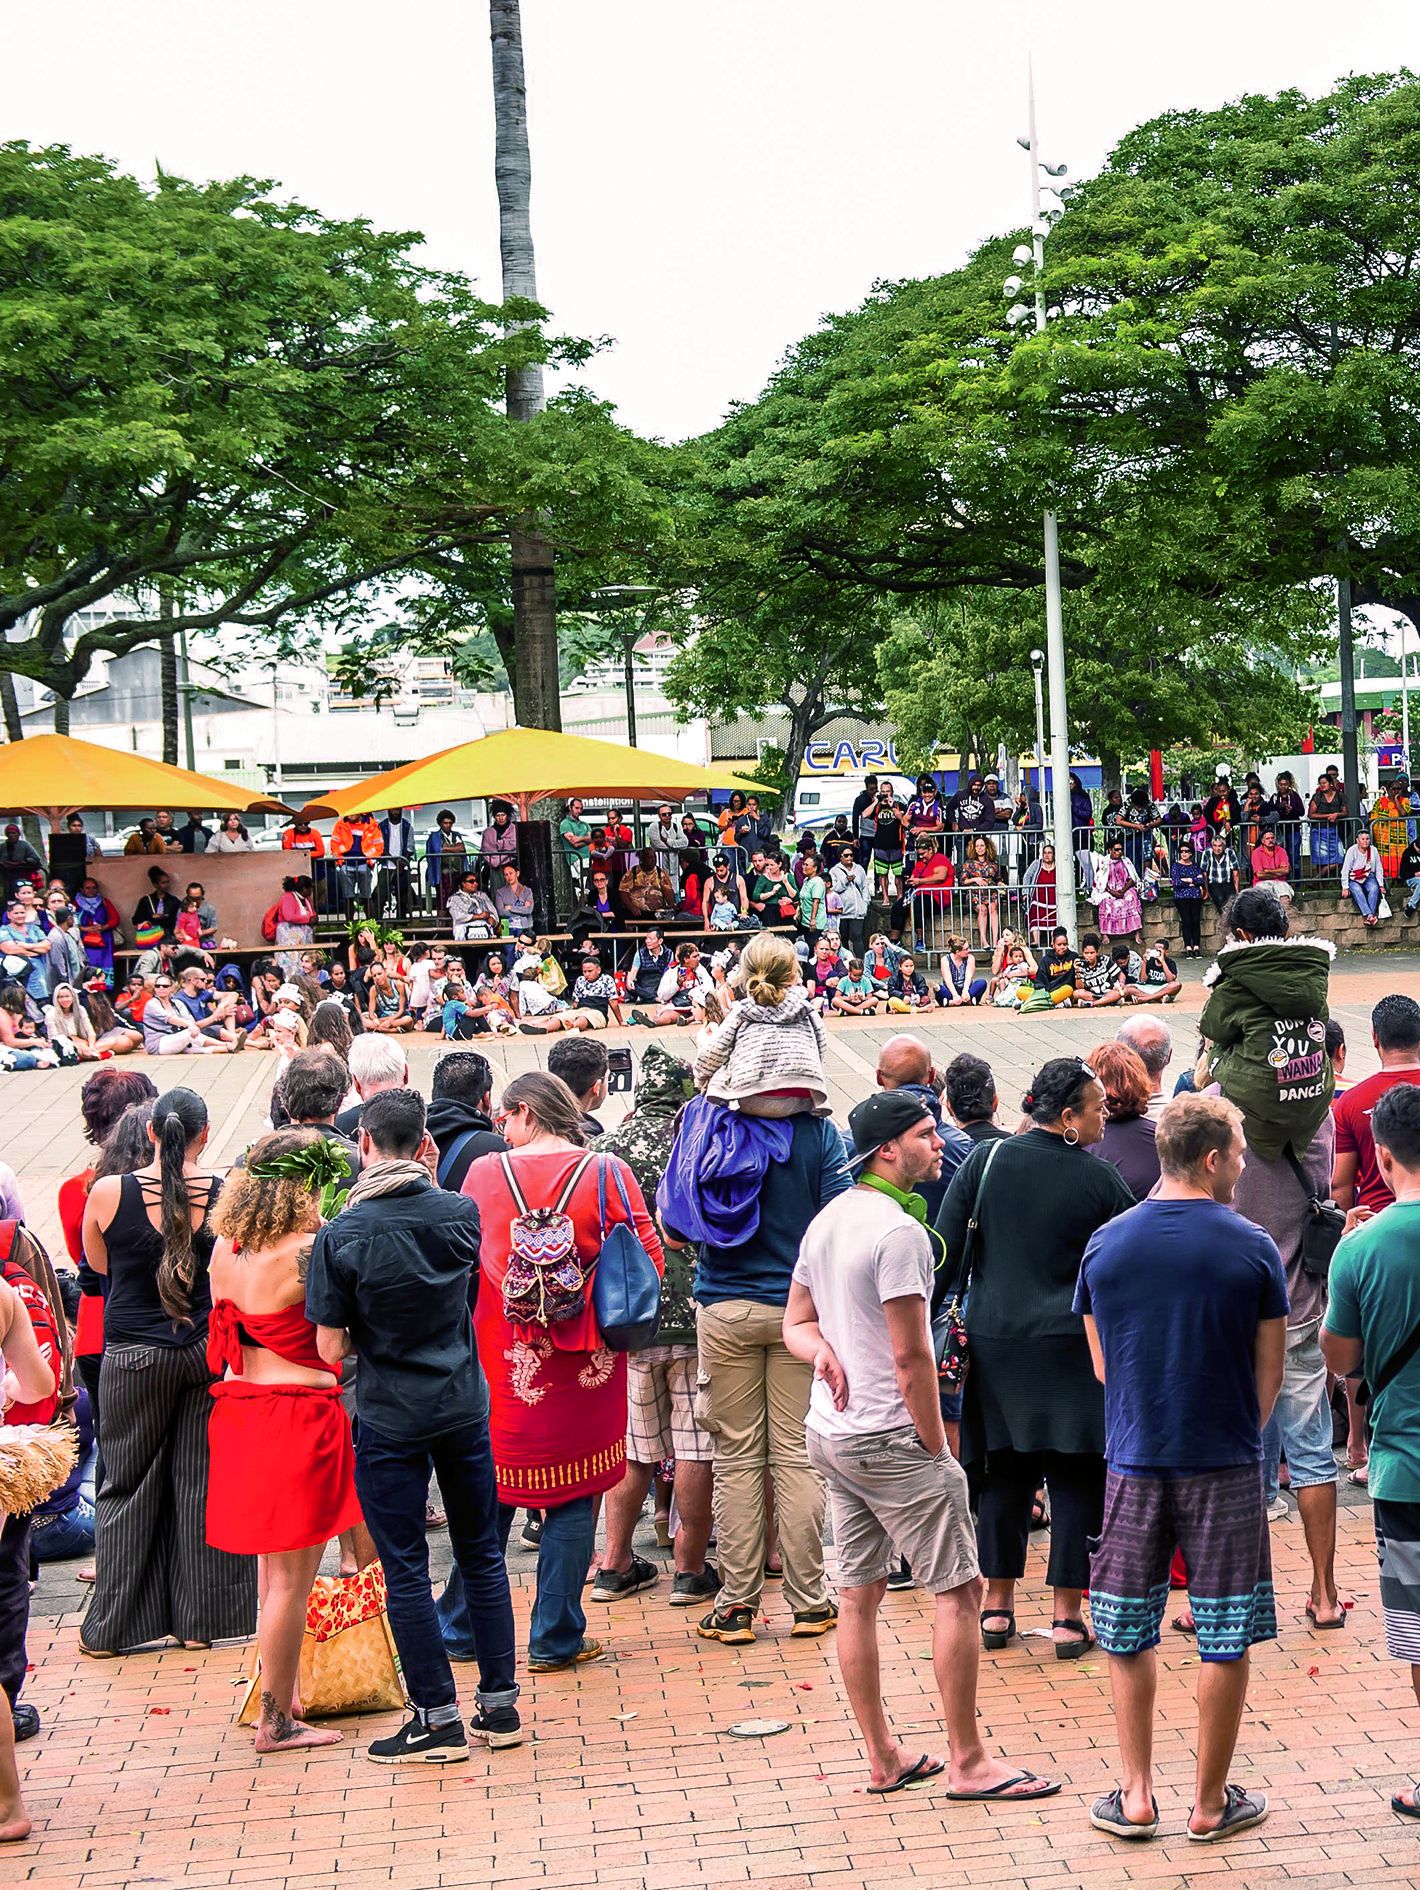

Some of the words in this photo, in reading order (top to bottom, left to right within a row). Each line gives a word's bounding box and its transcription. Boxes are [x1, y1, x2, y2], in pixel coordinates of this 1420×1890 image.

[1272, 1035, 1310, 1057] YOU
[1281, 1053, 1323, 1081] WANNA
[1279, 1072, 1326, 1102] DANCE!
